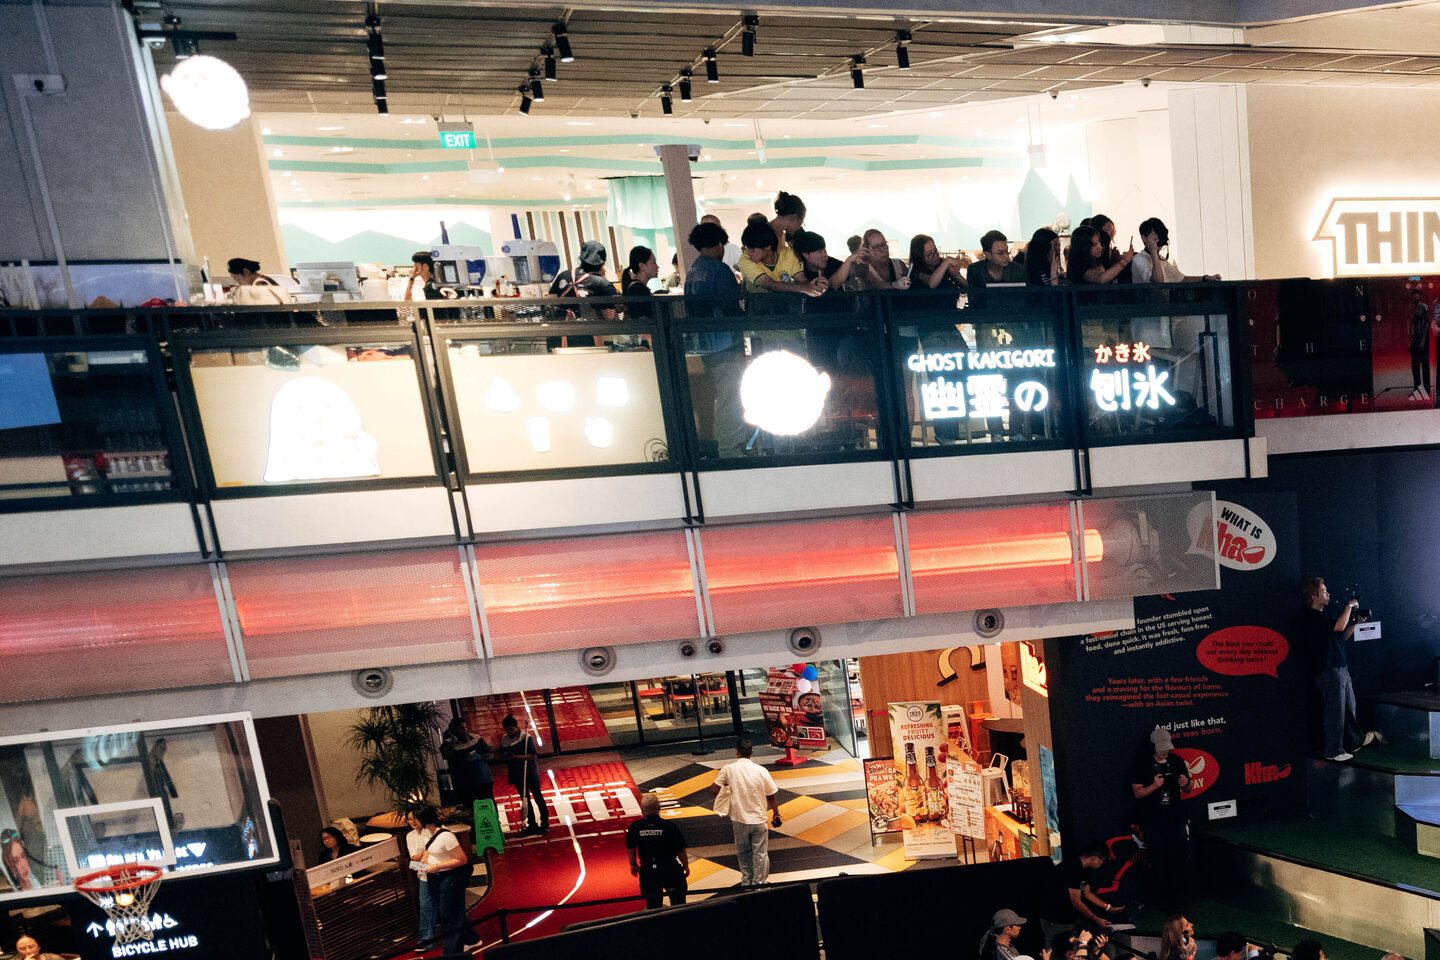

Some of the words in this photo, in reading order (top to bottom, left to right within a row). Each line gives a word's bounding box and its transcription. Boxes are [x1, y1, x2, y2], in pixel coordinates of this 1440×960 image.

[445, 134, 469, 146] EXIT
[908, 352, 965, 372] GHOST
[967, 349, 1055, 369] KAKIGORI
[1095, 342, 1150, 363] かき氷
[1221, 507, 1251, 531] WHAT
[1250, 526, 1262, 539] IS
[1137, 615, 1162, 625] founder
[1163, 610, 1192, 621] stumbled
[1193, 606, 1209, 615] upon
[1086, 632, 1119, 643] fast-casual
[1120, 628, 1136, 638] chain
[1144, 623, 1155, 632] the
[1167, 618, 1190, 629] serving
[1191, 613, 1212, 623] honest
[1104, 640, 1120, 648] done
[1122, 637, 1140, 648] quick.
[1127, 642, 1154, 653] instantly
[1155, 636, 1185, 646] addictive.
[1113, 686, 1138, 694] craving
[1155, 723, 1172, 731] And
[1173, 720, 1189, 731] just
[1191, 718, 1205, 728] like
[1207, 717, 1226, 725] that,
[1201, 726, 1223, 735] born.
[112, 938, 168, 958] BICYCLE
[169, 935, 198, 949] HUB
